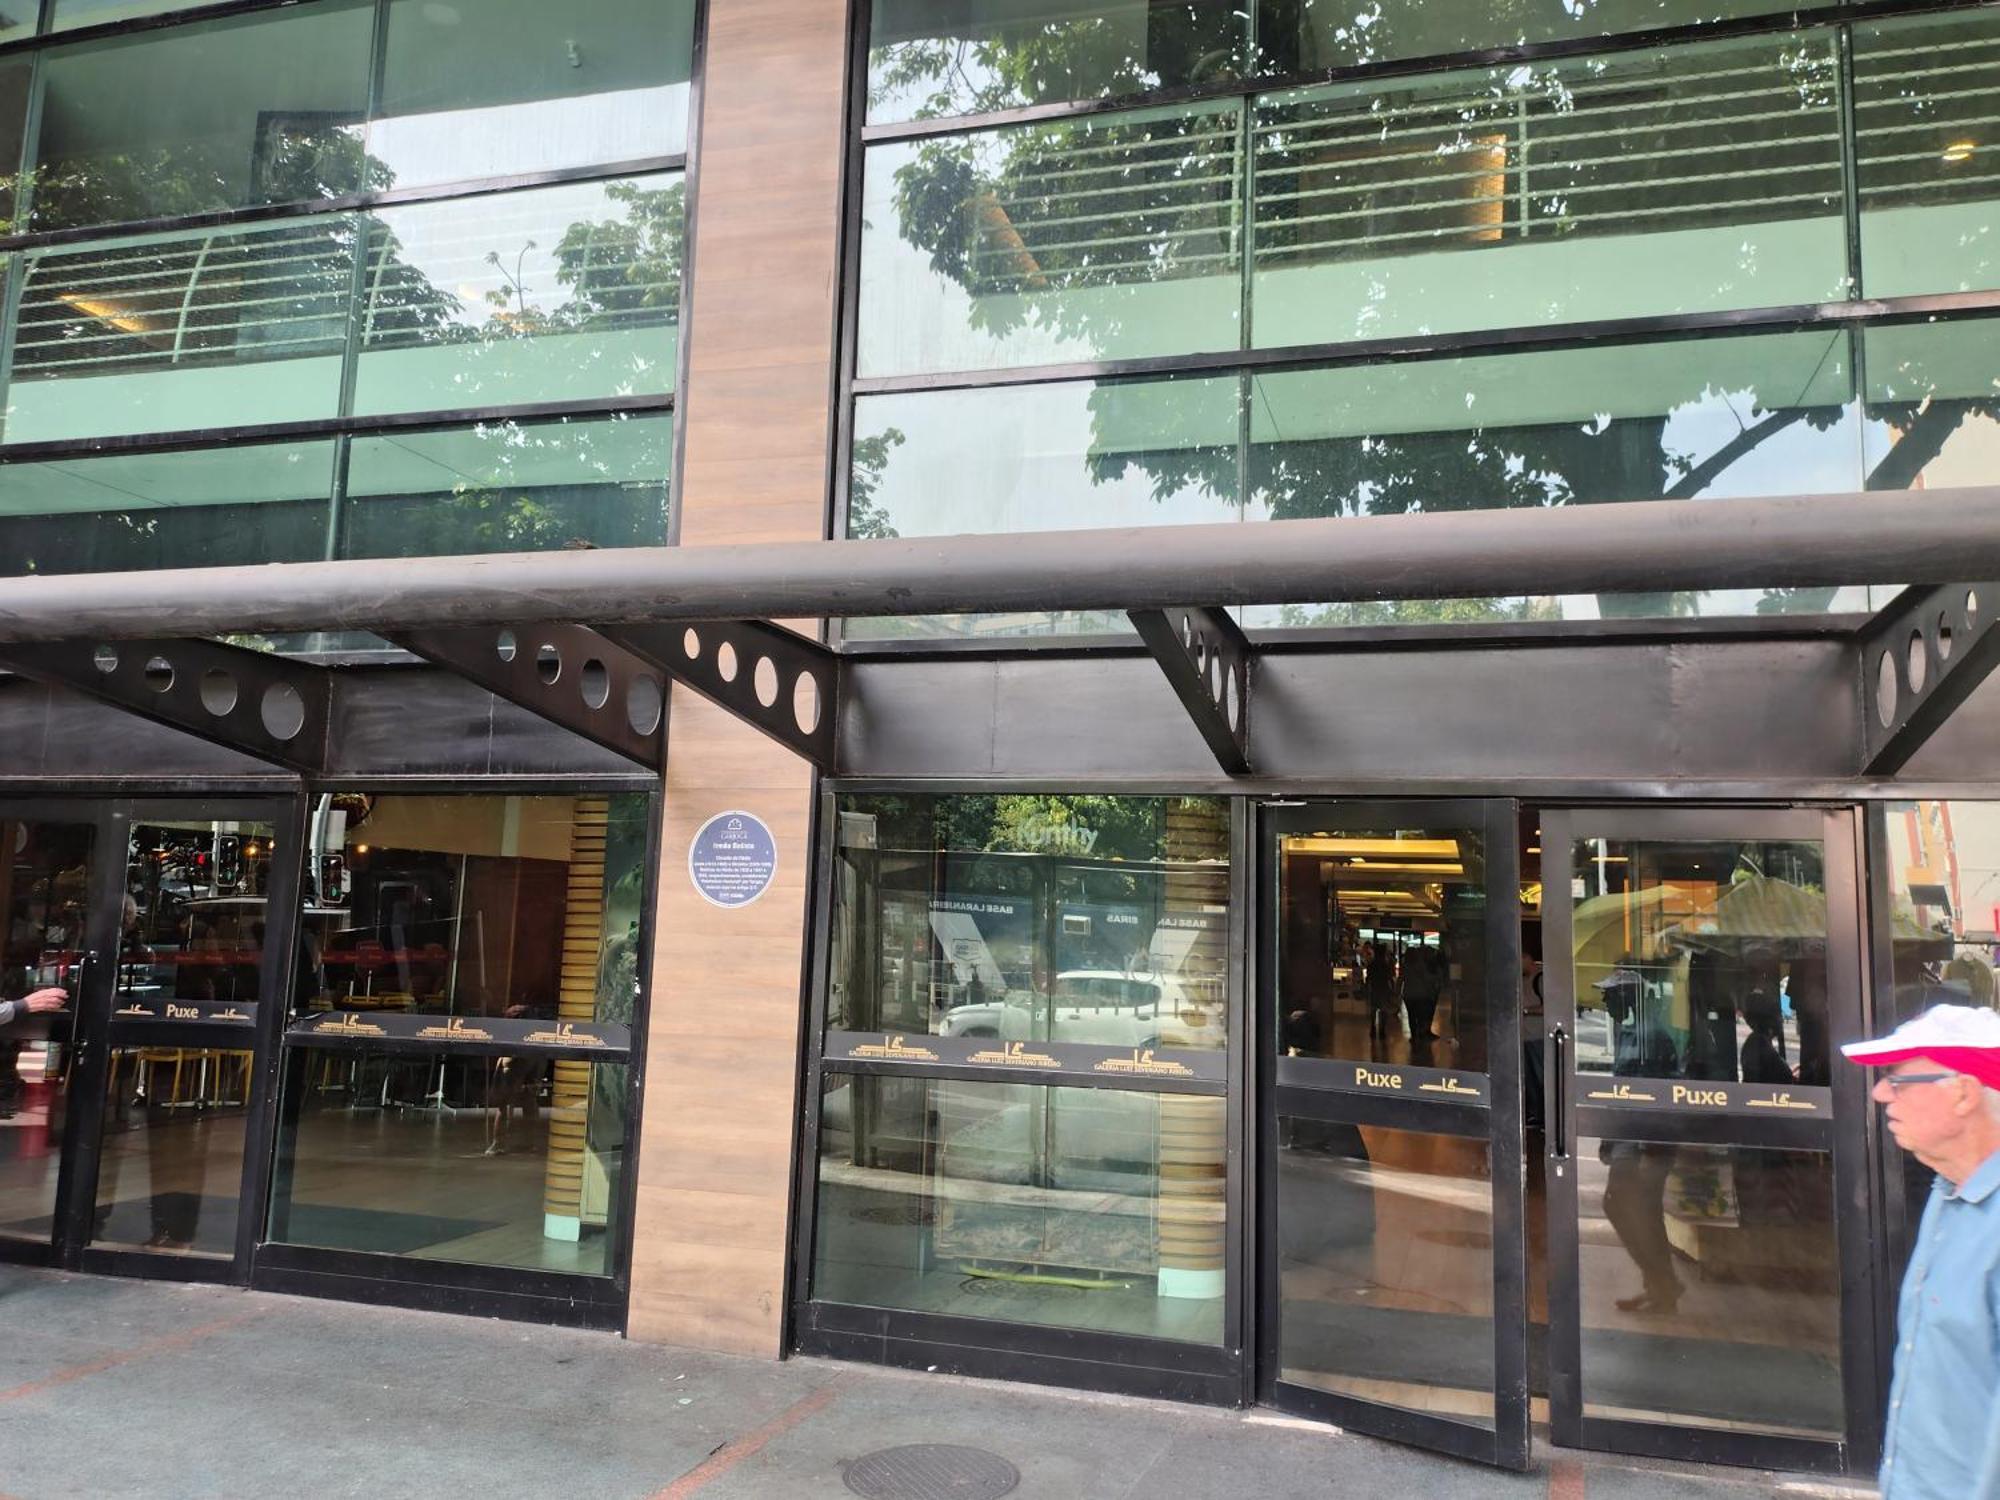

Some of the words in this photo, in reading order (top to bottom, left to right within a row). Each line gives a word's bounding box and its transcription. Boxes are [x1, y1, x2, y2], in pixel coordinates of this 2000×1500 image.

[166, 1004, 199, 1019] Puxe
[1355, 1067, 1402, 1089] Puxe
[1672, 1085, 1728, 1106] Puxe
